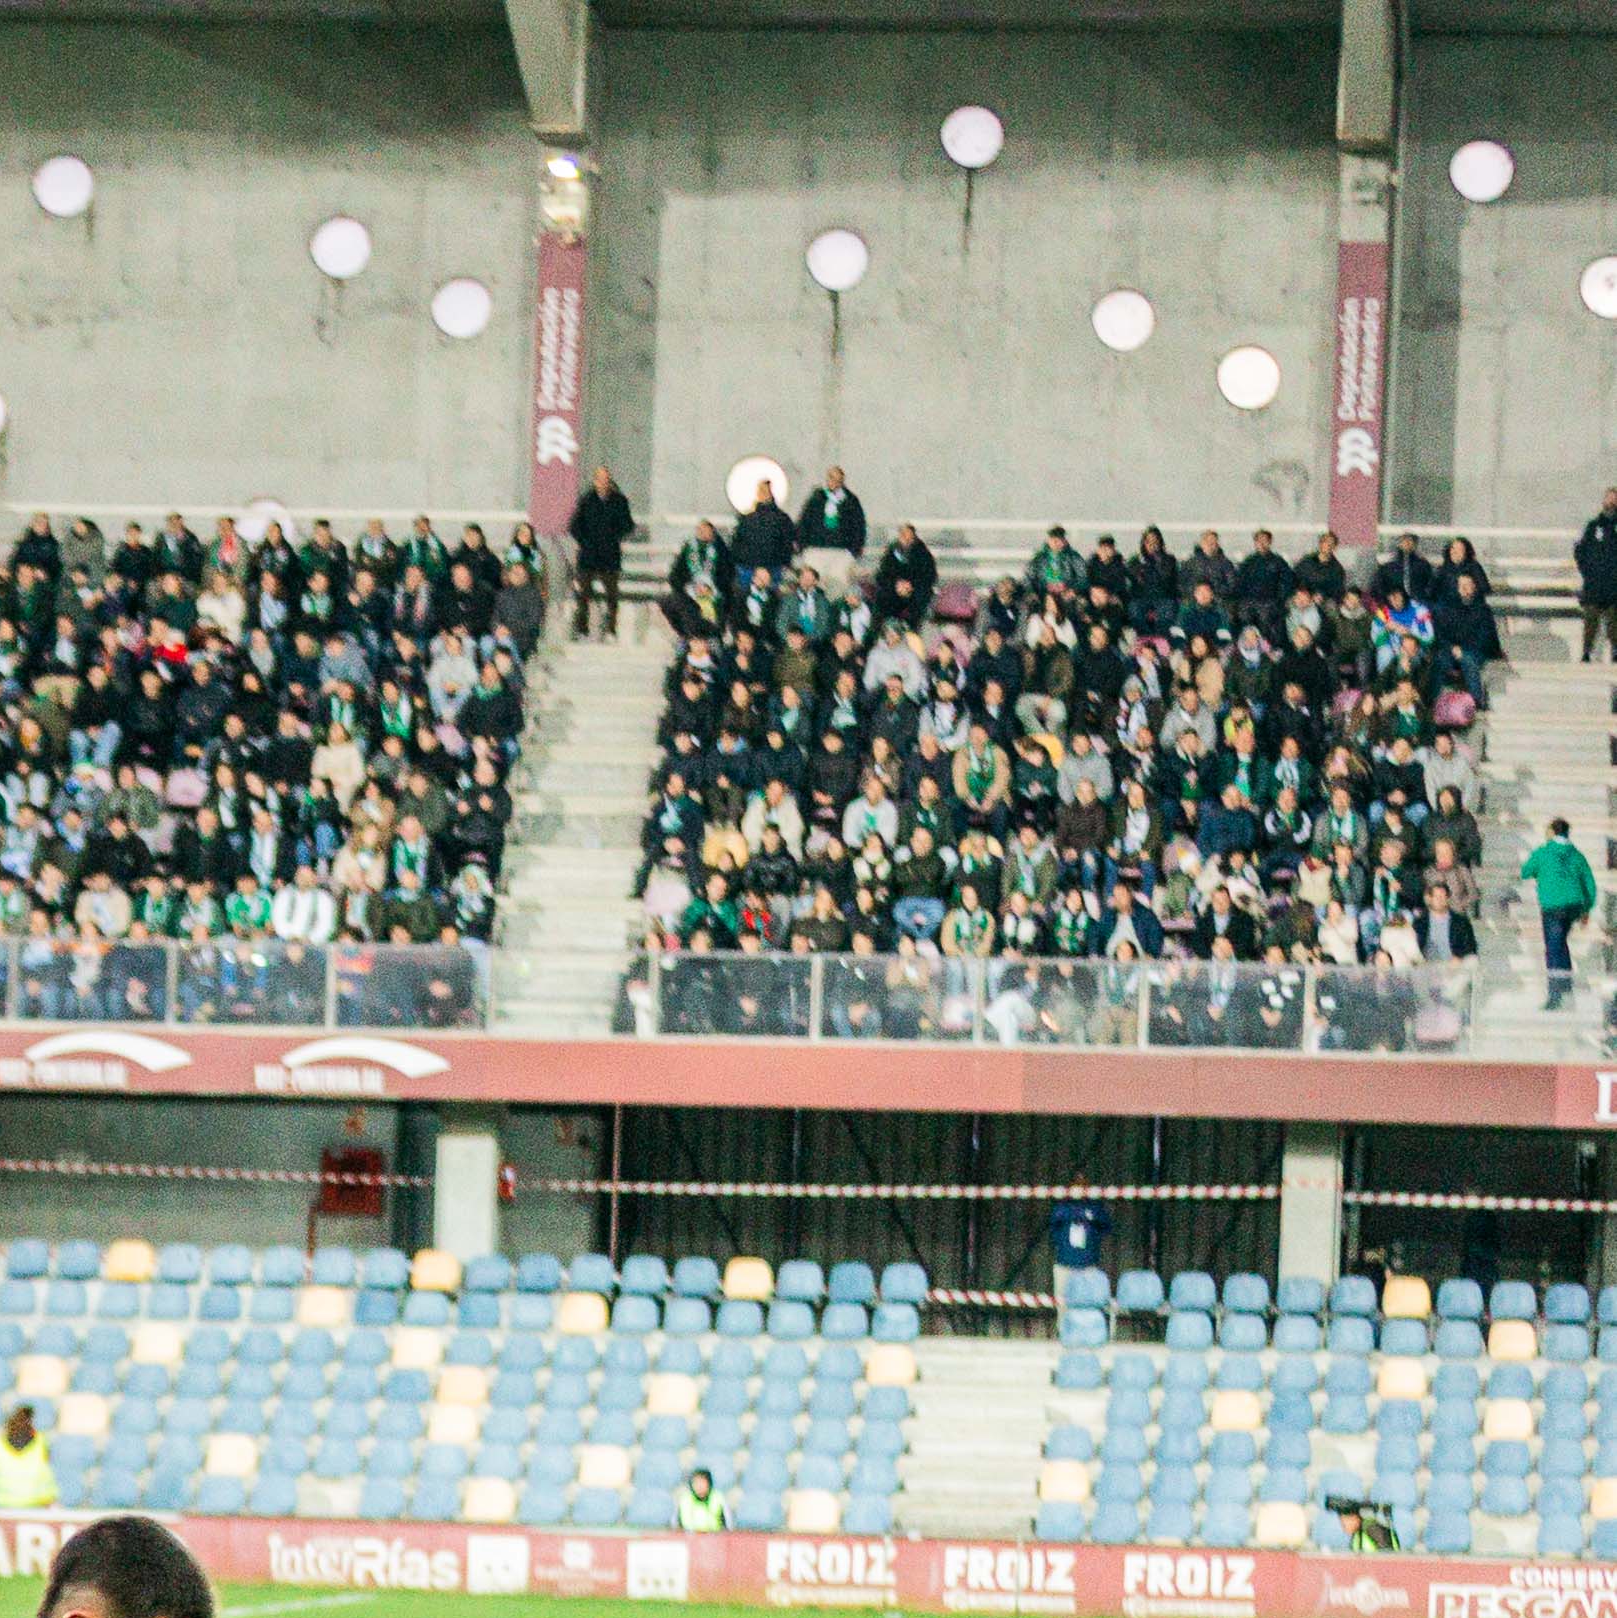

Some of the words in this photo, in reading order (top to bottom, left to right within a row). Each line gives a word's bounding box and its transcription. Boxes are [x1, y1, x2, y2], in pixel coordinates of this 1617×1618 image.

[767, 1540, 896, 1586] FROIZ
[944, 1546, 1076, 1592] FROIZ
[1123, 1553, 1255, 1599] FROIZ
